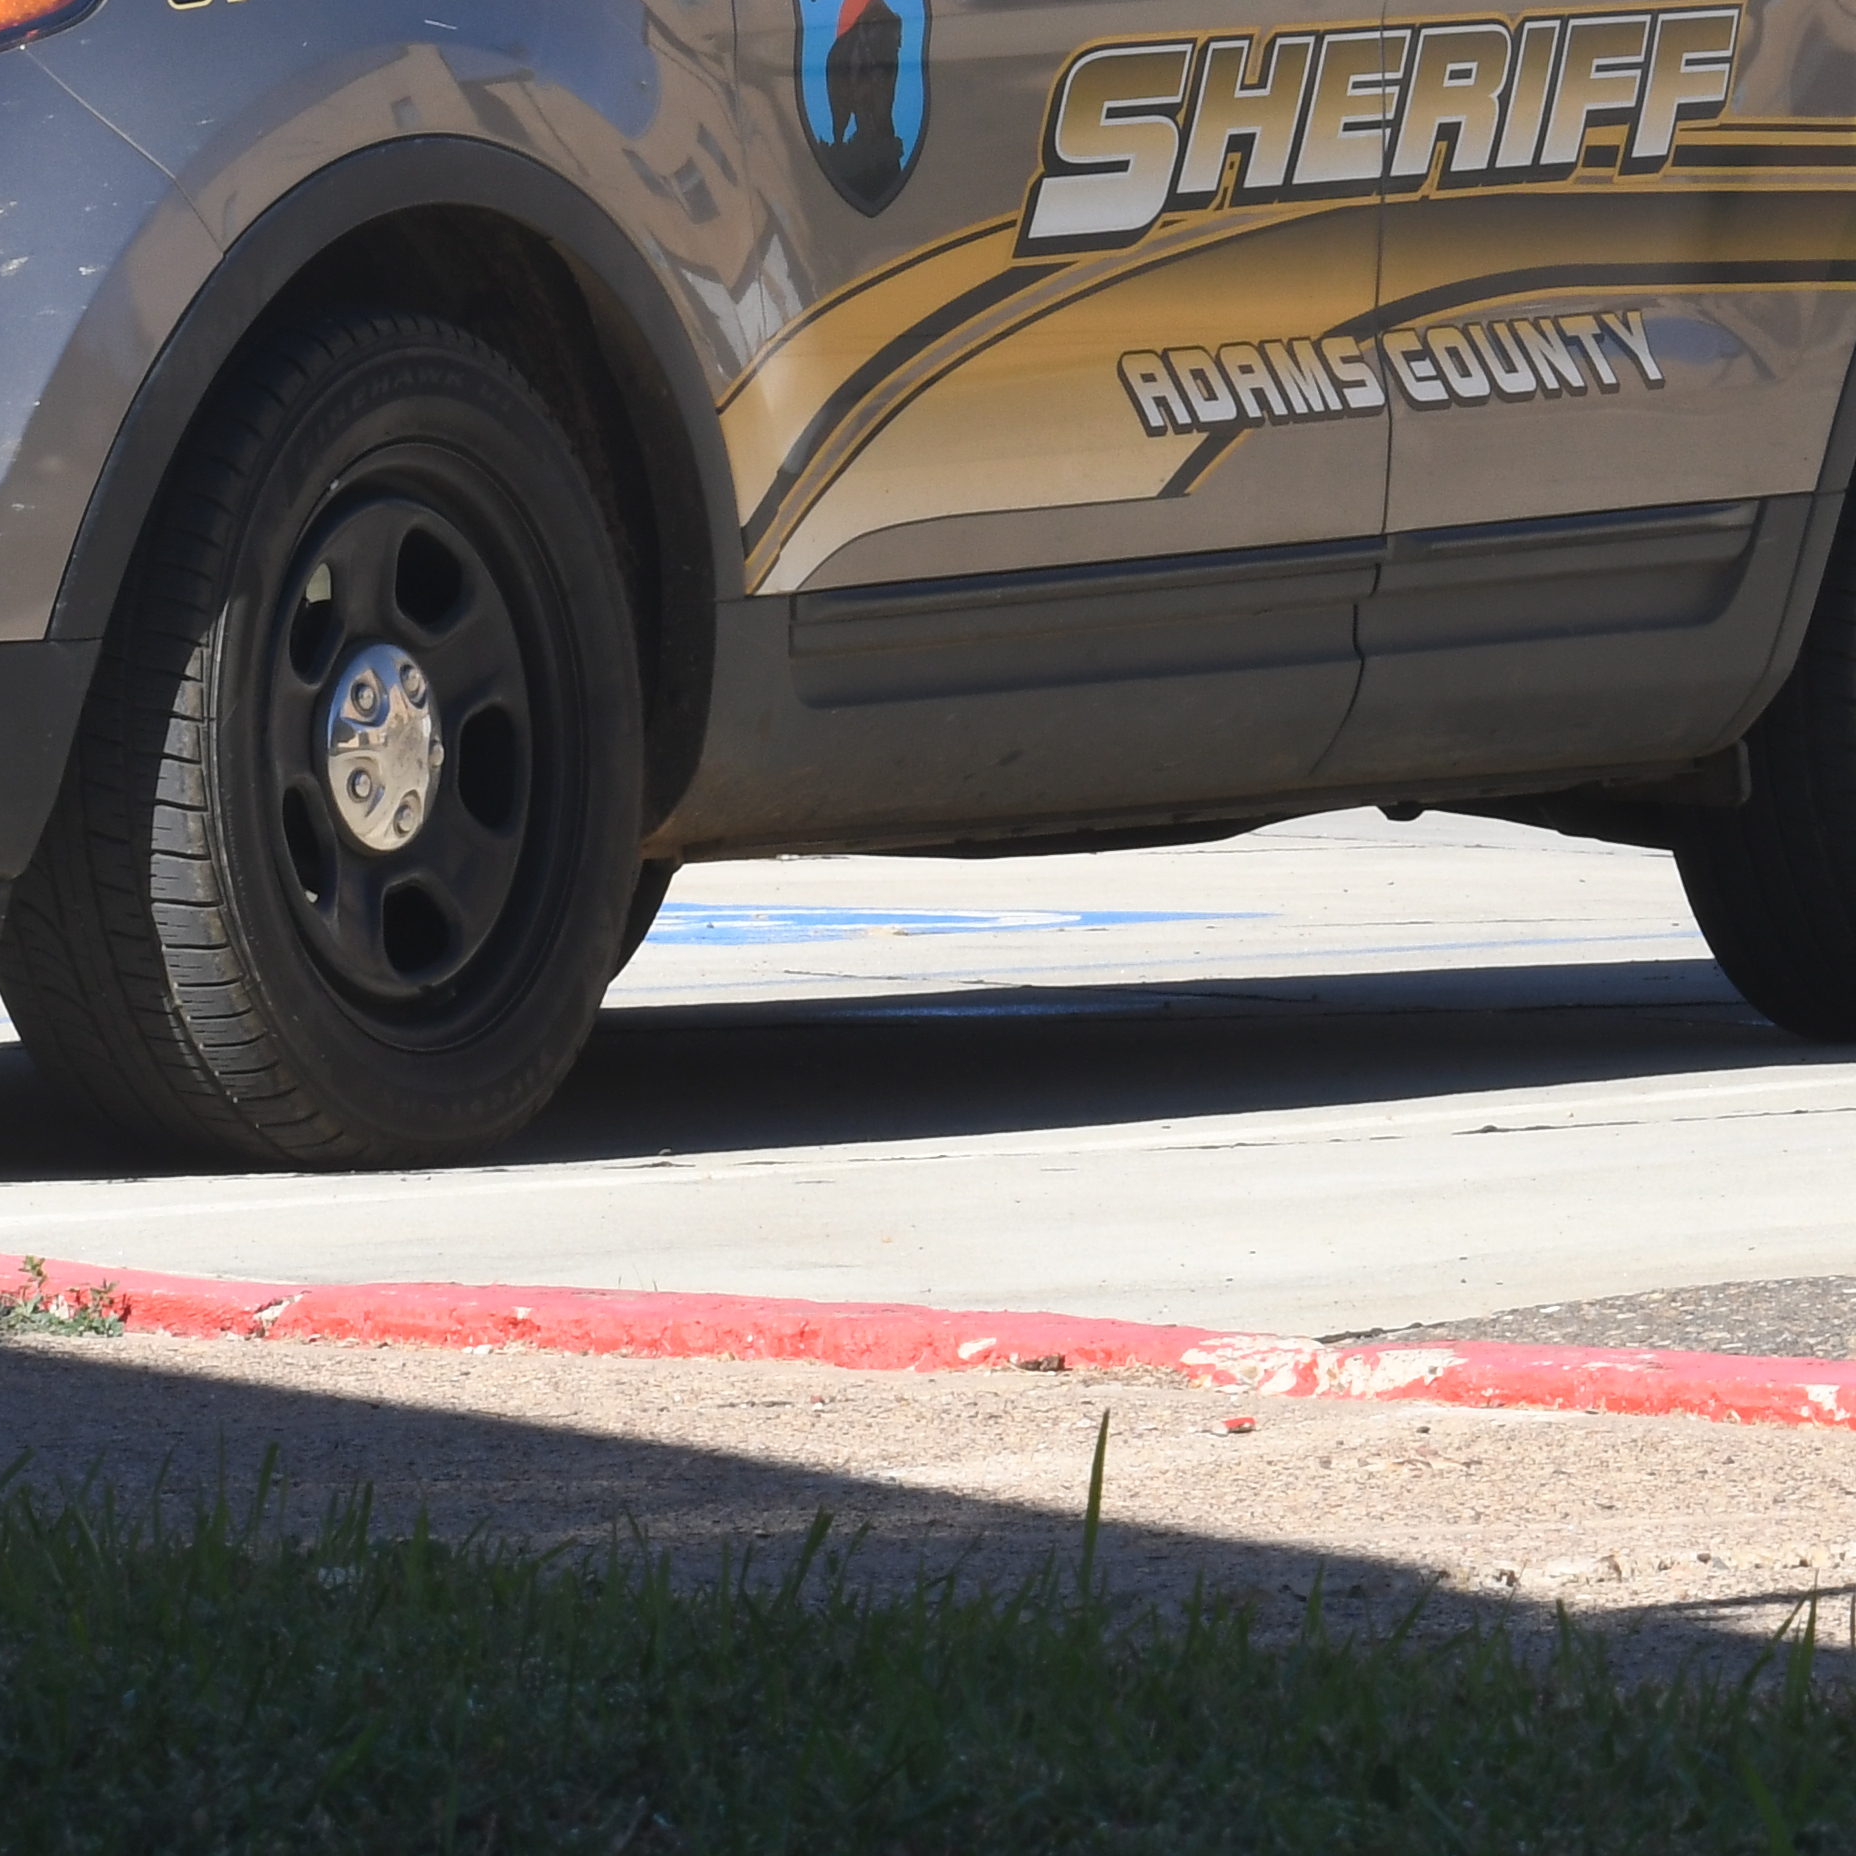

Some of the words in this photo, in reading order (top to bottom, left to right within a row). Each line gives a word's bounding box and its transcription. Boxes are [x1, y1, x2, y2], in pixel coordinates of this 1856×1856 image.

[1014, 4, 1744, 256] SHERIFF
[1118, 336, 1387, 436] ADAMS
[1380, 310, 1666, 411] COUNTY
